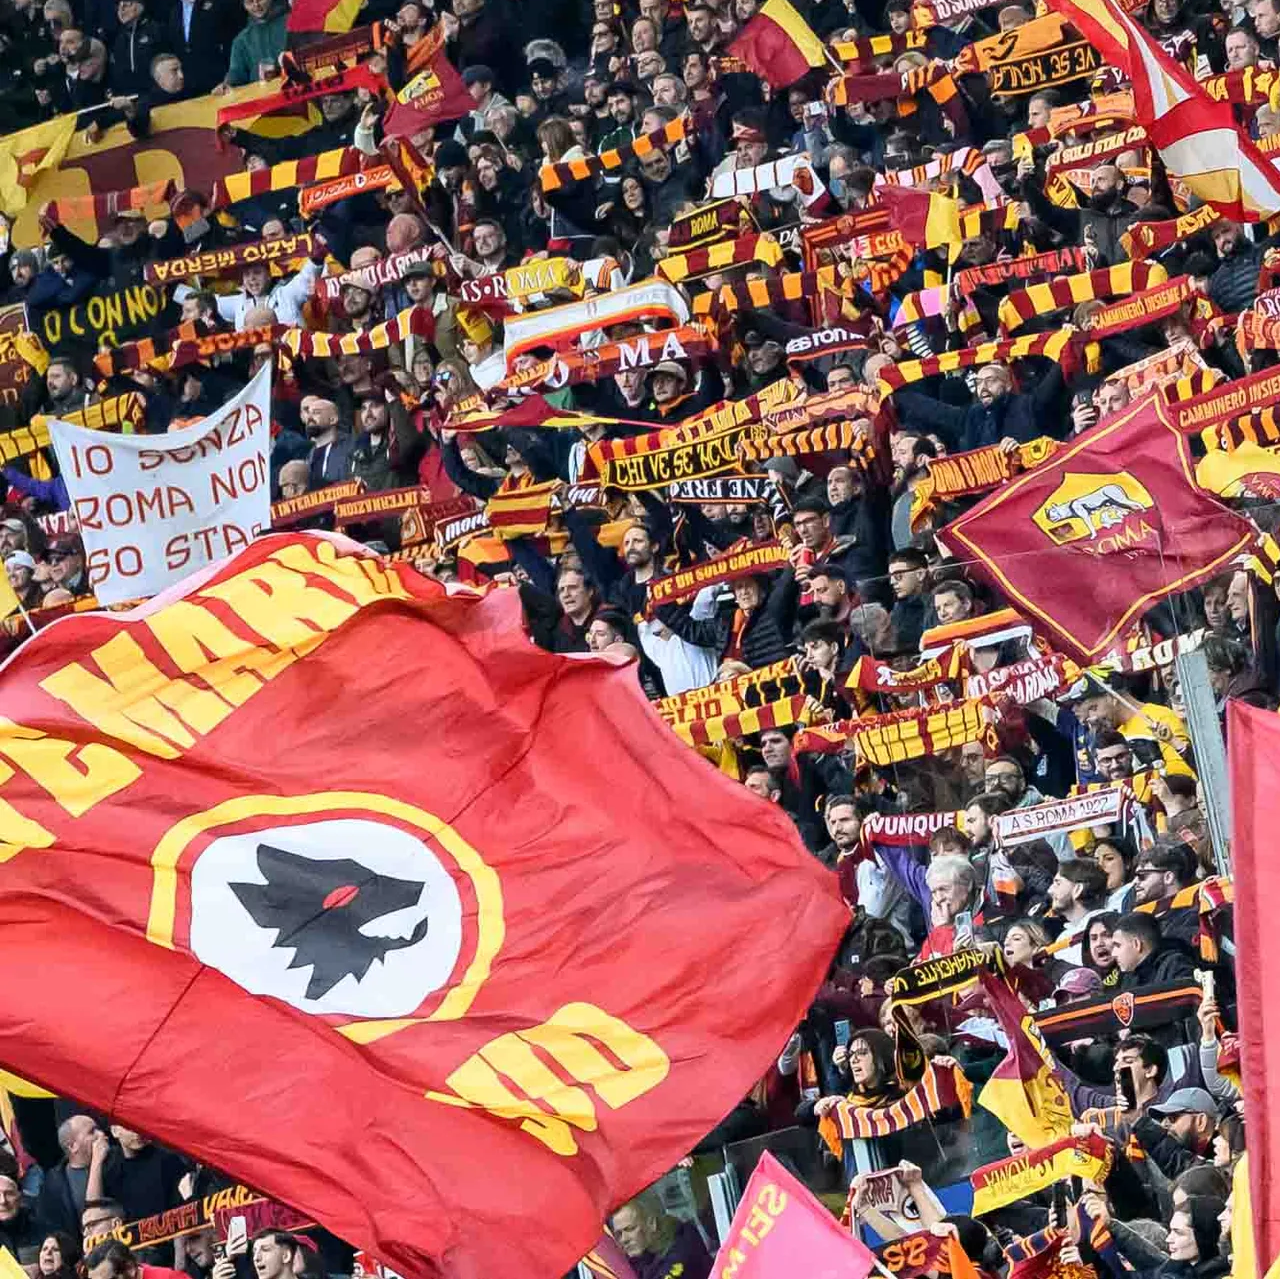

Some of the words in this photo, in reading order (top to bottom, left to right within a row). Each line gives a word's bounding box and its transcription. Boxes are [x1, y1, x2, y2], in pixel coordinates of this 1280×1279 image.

[1064, 136, 1089, 164] SOLO
[1091, 128, 1122, 158] STAR
[690, 213, 719, 235] ROMA
[377, 256, 394, 286] LA
[72, 435, 114, 477] IO
[138, 401, 265, 467] SENZA
[616, 450, 646, 486] CHI
[652, 445, 671, 479] VE
[674, 441, 693, 475] SE
[973, 448, 1009, 487] MORTE
[75, 472, 192, 532] ROMA
[89, 539, 143, 585] SO
[685, 674, 734, 705] SOLO
[1025, 667, 1058, 700] ROMA
[1038, 802, 1075, 828] ROMA
